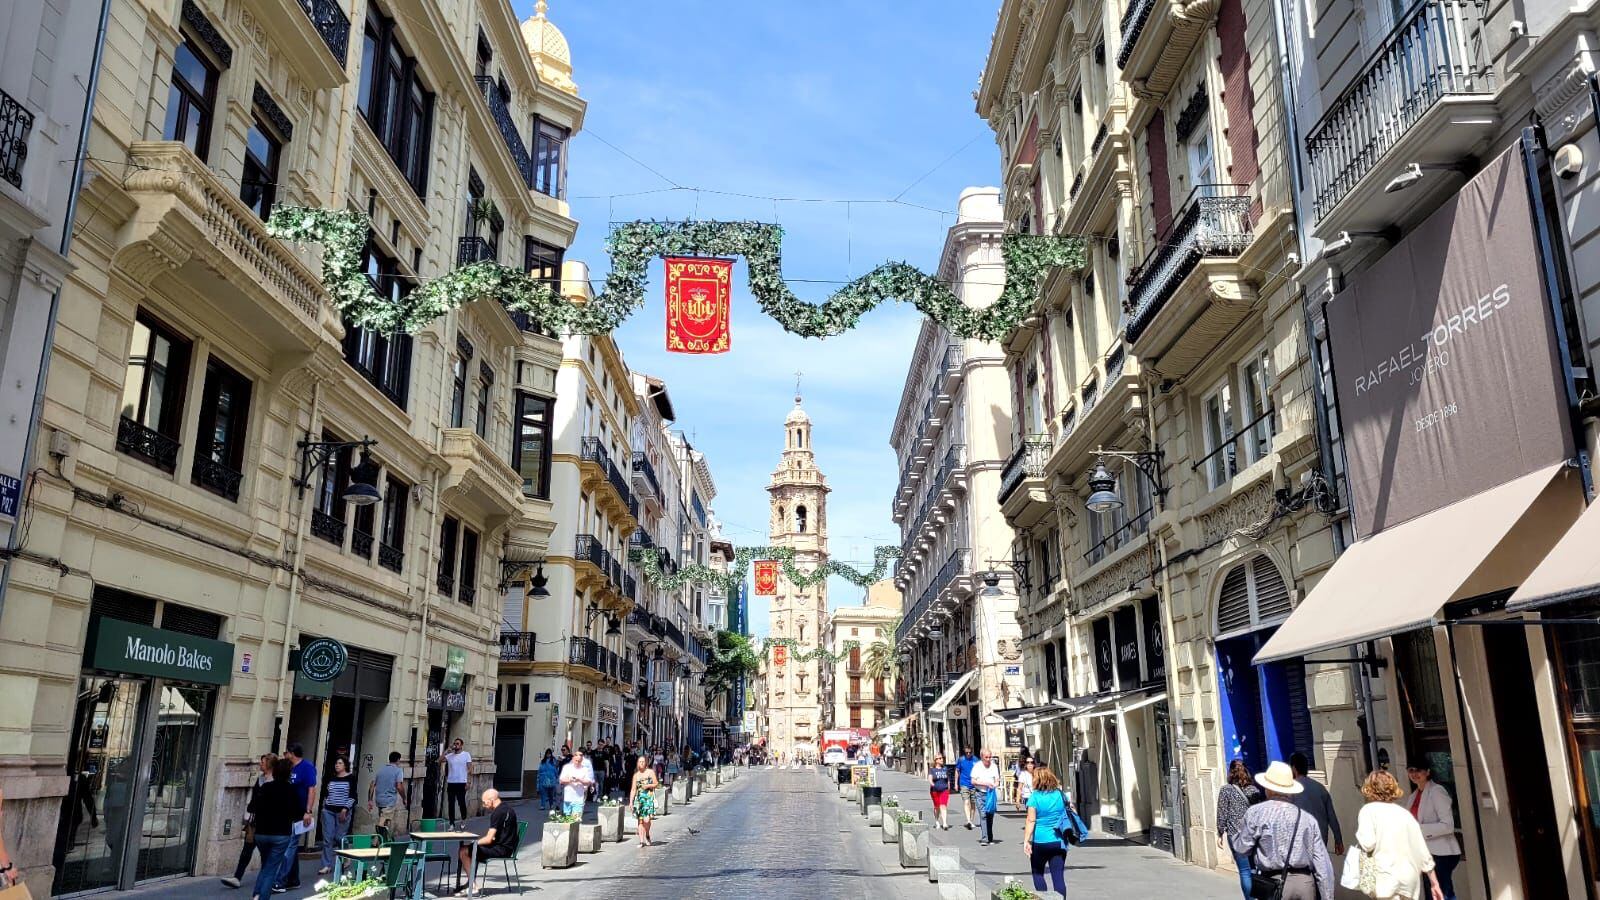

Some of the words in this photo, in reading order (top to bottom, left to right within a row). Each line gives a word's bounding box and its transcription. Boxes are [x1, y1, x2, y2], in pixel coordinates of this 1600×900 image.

[1355, 344, 1424, 397] RAFAEL
[1421, 283, 1511, 353] TORRES
[1409, 351, 1450, 386] JOYERO
[1415, 410, 1440, 433] DESDE
[1440, 402, 1458, 420] 1896
[125, 635, 176, 666] Manolo
[177, 646, 213, 671] Bakes
